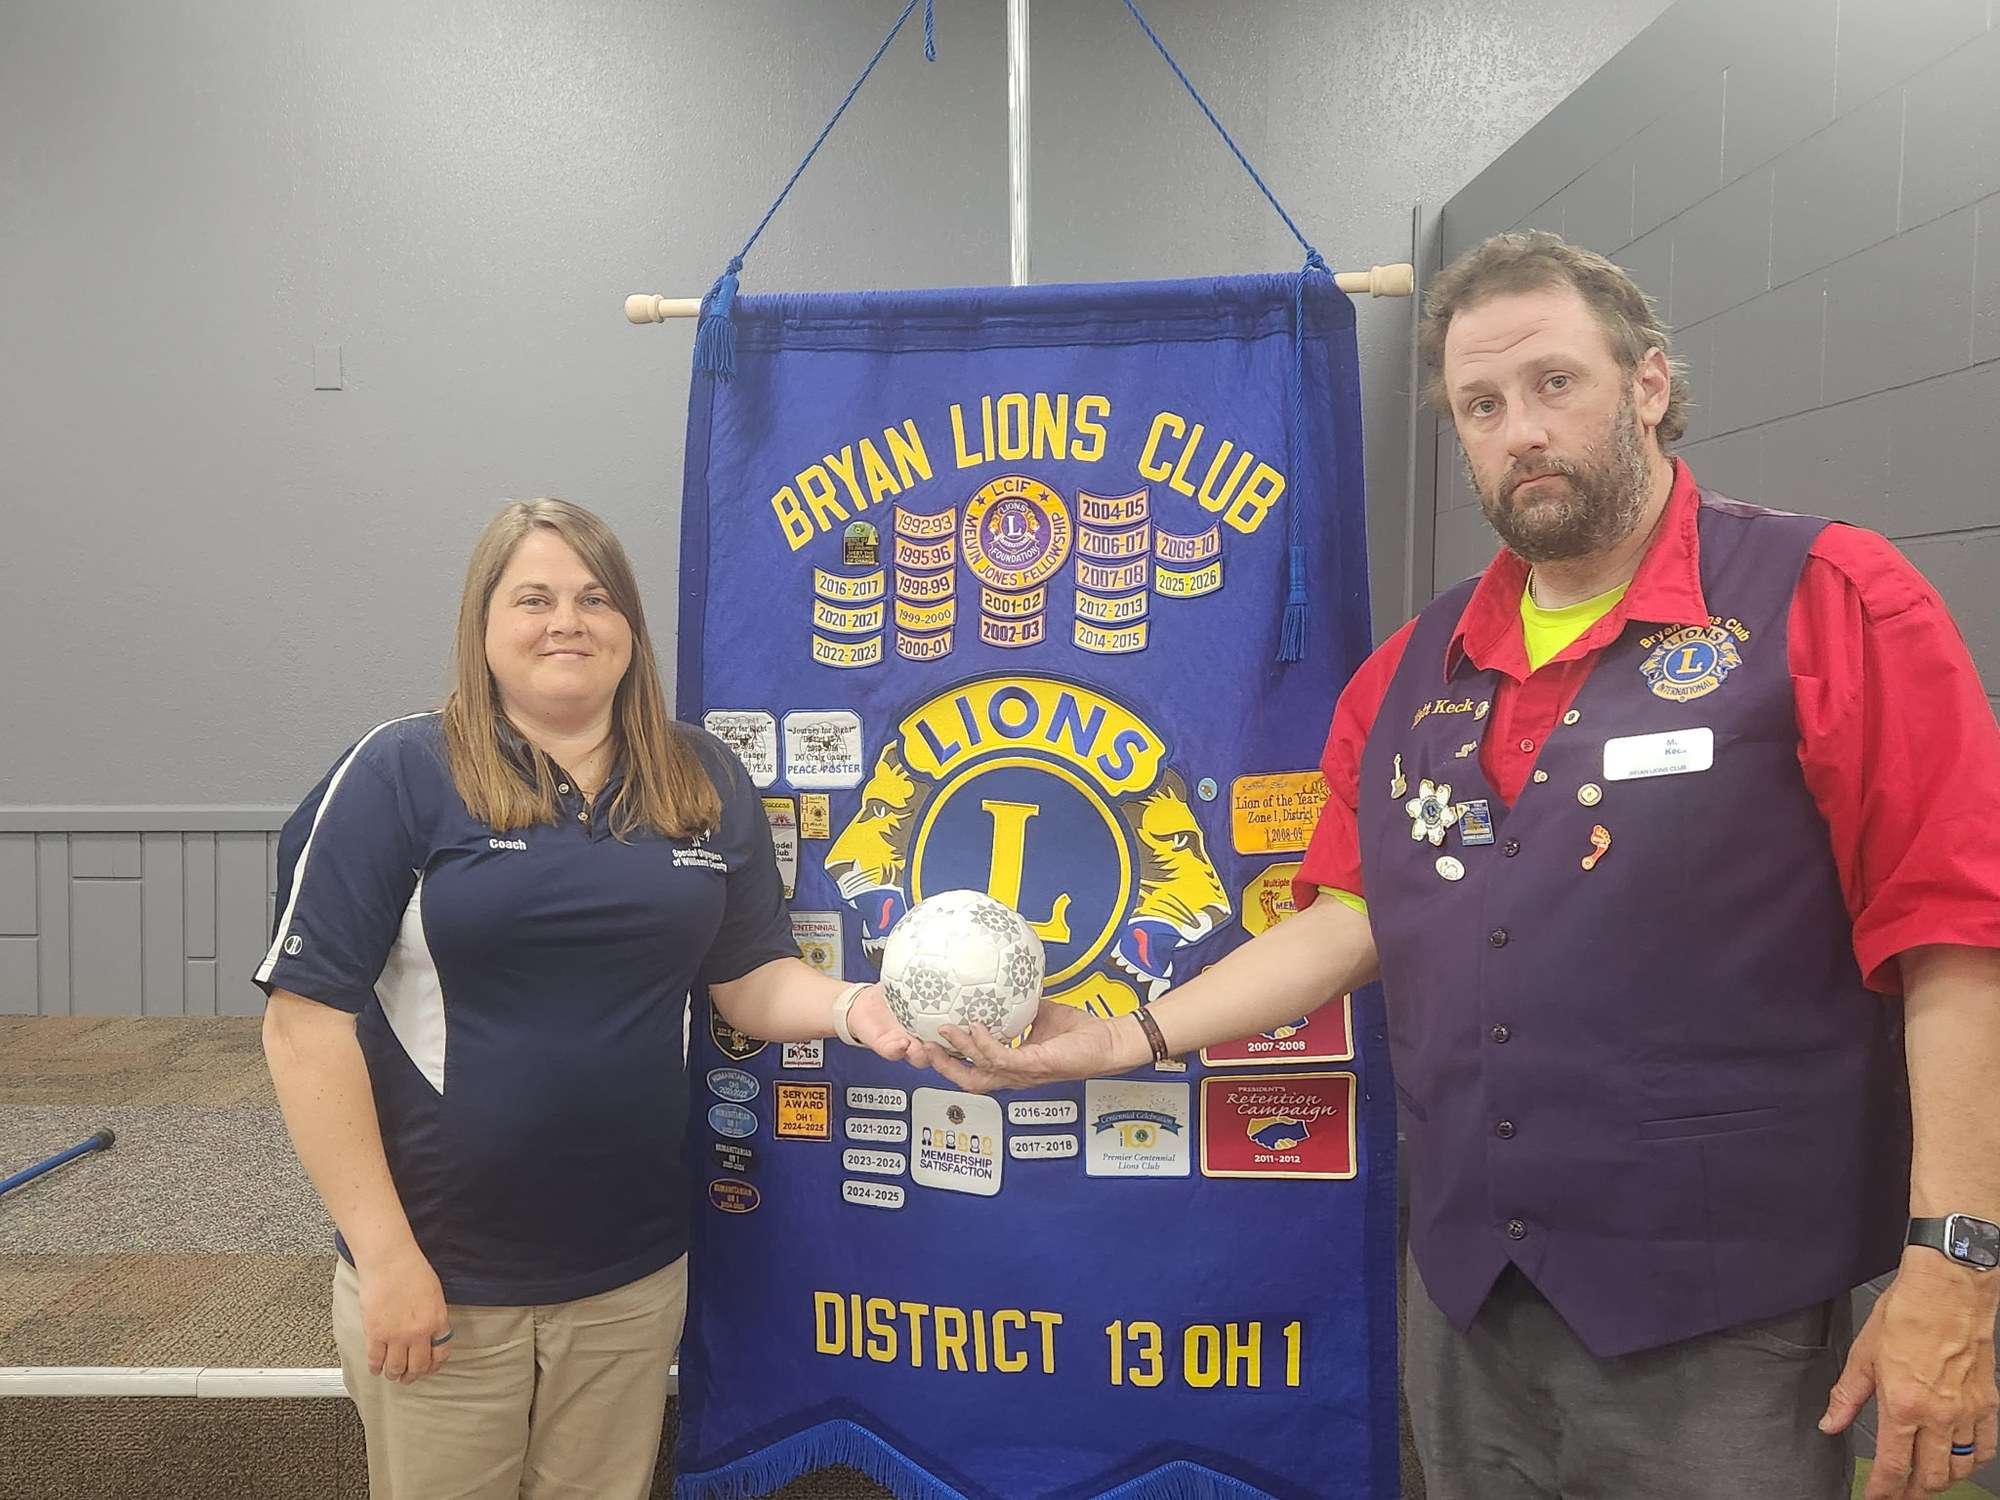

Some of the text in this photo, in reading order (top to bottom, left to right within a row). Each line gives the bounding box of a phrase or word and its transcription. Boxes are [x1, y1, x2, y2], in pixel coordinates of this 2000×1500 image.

[770, 392, 1286, 552] BRYAN LIONS CLUB
[991, 479, 1031, 496] LCIF
[1000, 502, 1026, 513] LIONS
[1082, 497, 1144, 520] 2004-05
[898, 512, 953, 534] 1992-93
[1007, 515, 1022, 537] L
[964, 512, 1067, 586] MELVIN JONES FELLOWSHIP
[1082, 530, 1146, 554] 2006-07
[1161, 534, 1215, 559] 2009-10
[898, 545, 951, 565] 1995-96
[991, 545, 1038, 562] FOUNDATION
[1081, 565, 1144, 587] 2007-08
[1159, 570, 1217, 591] 2025-2026
[819, 576, 878, 596] 2016-2017
[898, 576, 950, 595] 1998-99
[984, 593, 1041, 612] 2001-02
[1079, 597, 1143, 618] 2012-2013
[818, 606, 878, 627] 2020-2021
[899, 609, 951, 624] 1999-2000
[983, 620, 1040, 642] 2002-03
[1078, 627, 1140, 648] 2014-2015
[1639, 617, 1751, 649] Bryan Club
[1664, 627, 1723, 647] LIONS
[816, 642, 877, 662] 2022-2023
[897, 637, 949, 656] 2000-01
[1675, 647, 1704, 674] L
[1431, 698, 1475, 714] Keck
[915, 685, 1151, 783] LIONS
[752, 763, 773, 773] YEAR
[787, 764, 860, 774] PEACE POSTER
[1235, 792, 1319, 810] Lion of the Year
[1247, 811, 1272, 824] Zone
[1283, 807, 1314, 822] District
[1271, 827, 1303, 842] 2008-09
[489, 838, 527, 851] Coach
[672, 858, 681, 867] of
[981, 799, 1074, 945] L
[792, 924, 839, 932] ENTENNIAL
[1247, 1040, 1306, 1052] 2007-2008
[782, 1090, 825, 1100] SERVICE
[851, 1092, 902, 1105] 2019-2020
[1226, 1092, 1322, 1104] Retention
[784, 1100, 824, 1110] AWARD
[1014, 1106, 1071, 1118] 2016-2017
[1237, 1101, 1337, 1122] Campaign
[796, 1113, 807, 1122] OH
[1100, 1111, 1175, 1124] Centennial Celebration
[850, 1123, 902, 1136] 2021-2022
[1015, 1140, 1073, 1153] 2017-2018
[847, 1154, 901, 1168] 2023-2024
[920, 1149, 993, 1168] MEMBERSHIP
[1103, 1153, 1176, 1161] Premier Centennial
[1118, 1161, 1161, 1170] Lions Club
[1254, 1154, 1301, 1164] 2011-2012
[919, 1159, 993, 1180] SATISFACTION
[846, 1186, 899, 1201] 2024-2025
[814, 1291, 1301, 1388] DISTRICT 13 OH 1
